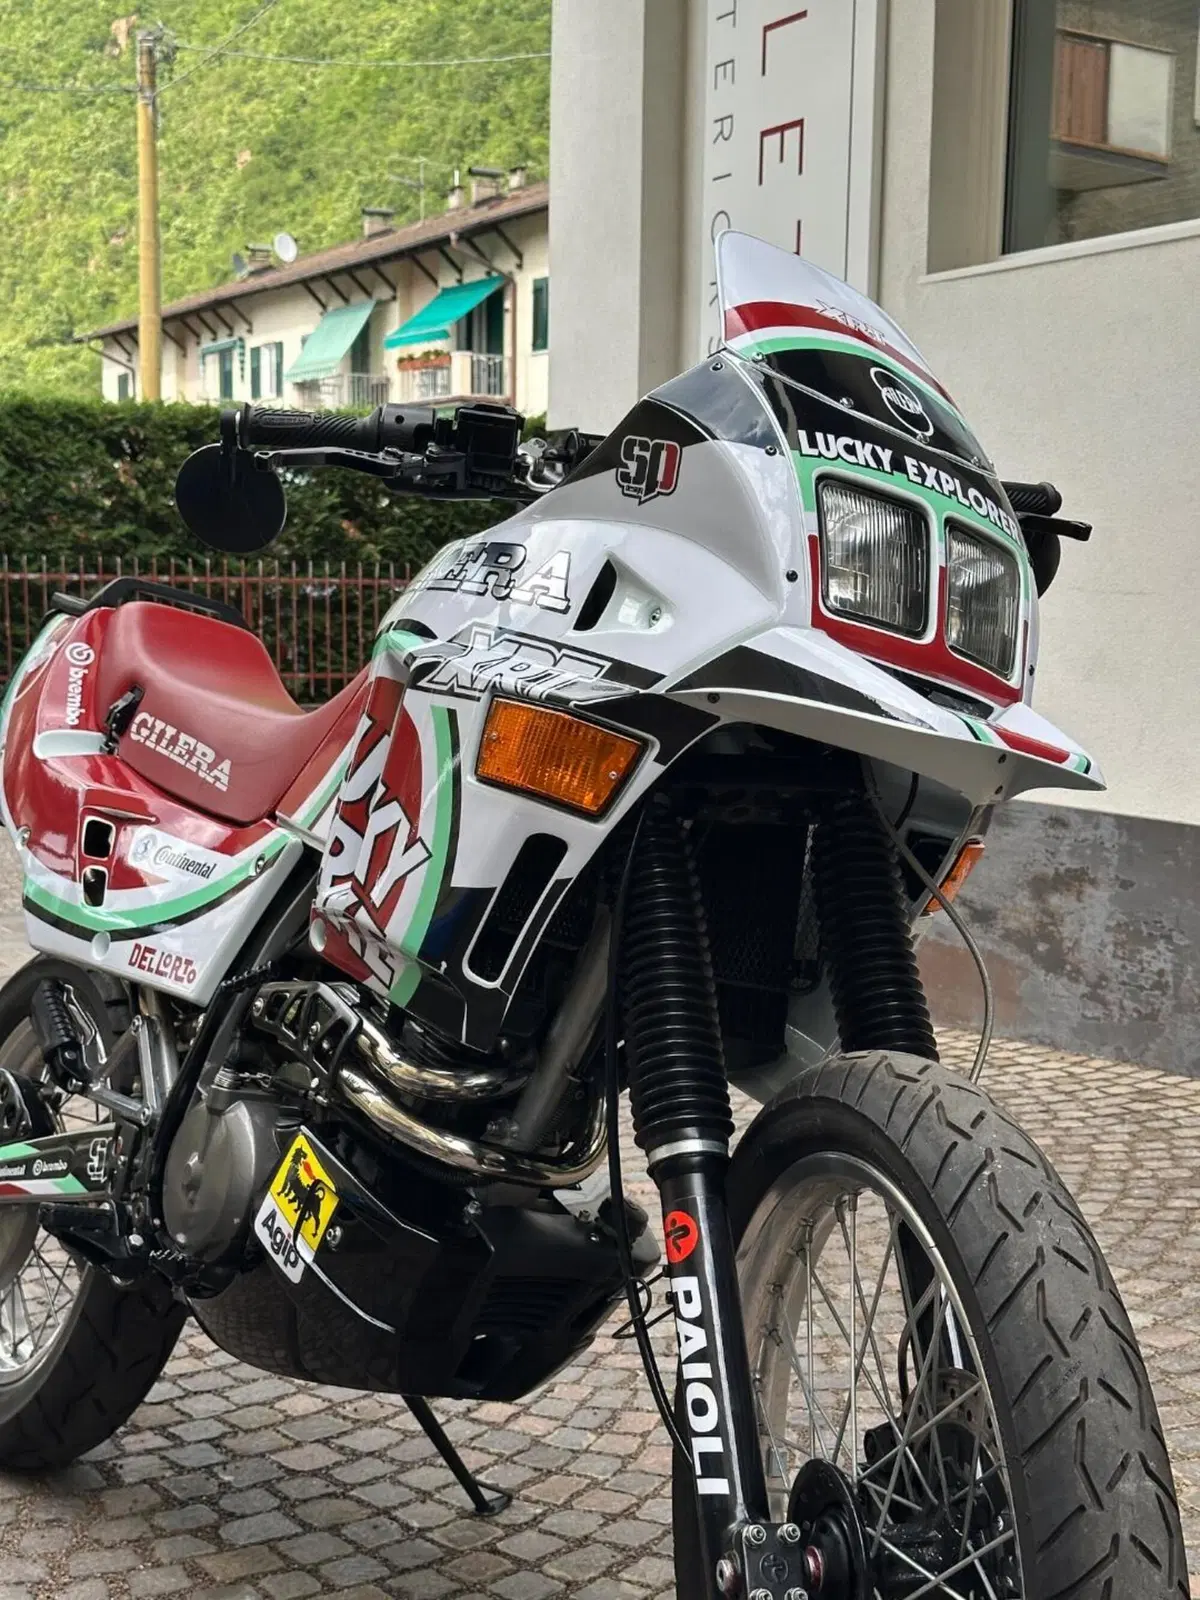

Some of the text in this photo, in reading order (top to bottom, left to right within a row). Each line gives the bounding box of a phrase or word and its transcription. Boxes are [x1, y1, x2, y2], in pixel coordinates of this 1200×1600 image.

[798, 429, 1022, 548] LUCKY EXPLORER
[65, 666, 89, 725] brembo
[416, 626, 614, 703] XRT
[130, 711, 232, 792] GILERA
[153, 845, 218, 880] Continental
[127, 942, 197, 984] DELLORTO
[261, 1208, 301, 1269] Agip
[670, 1276, 731, 1496] PAIOLI
